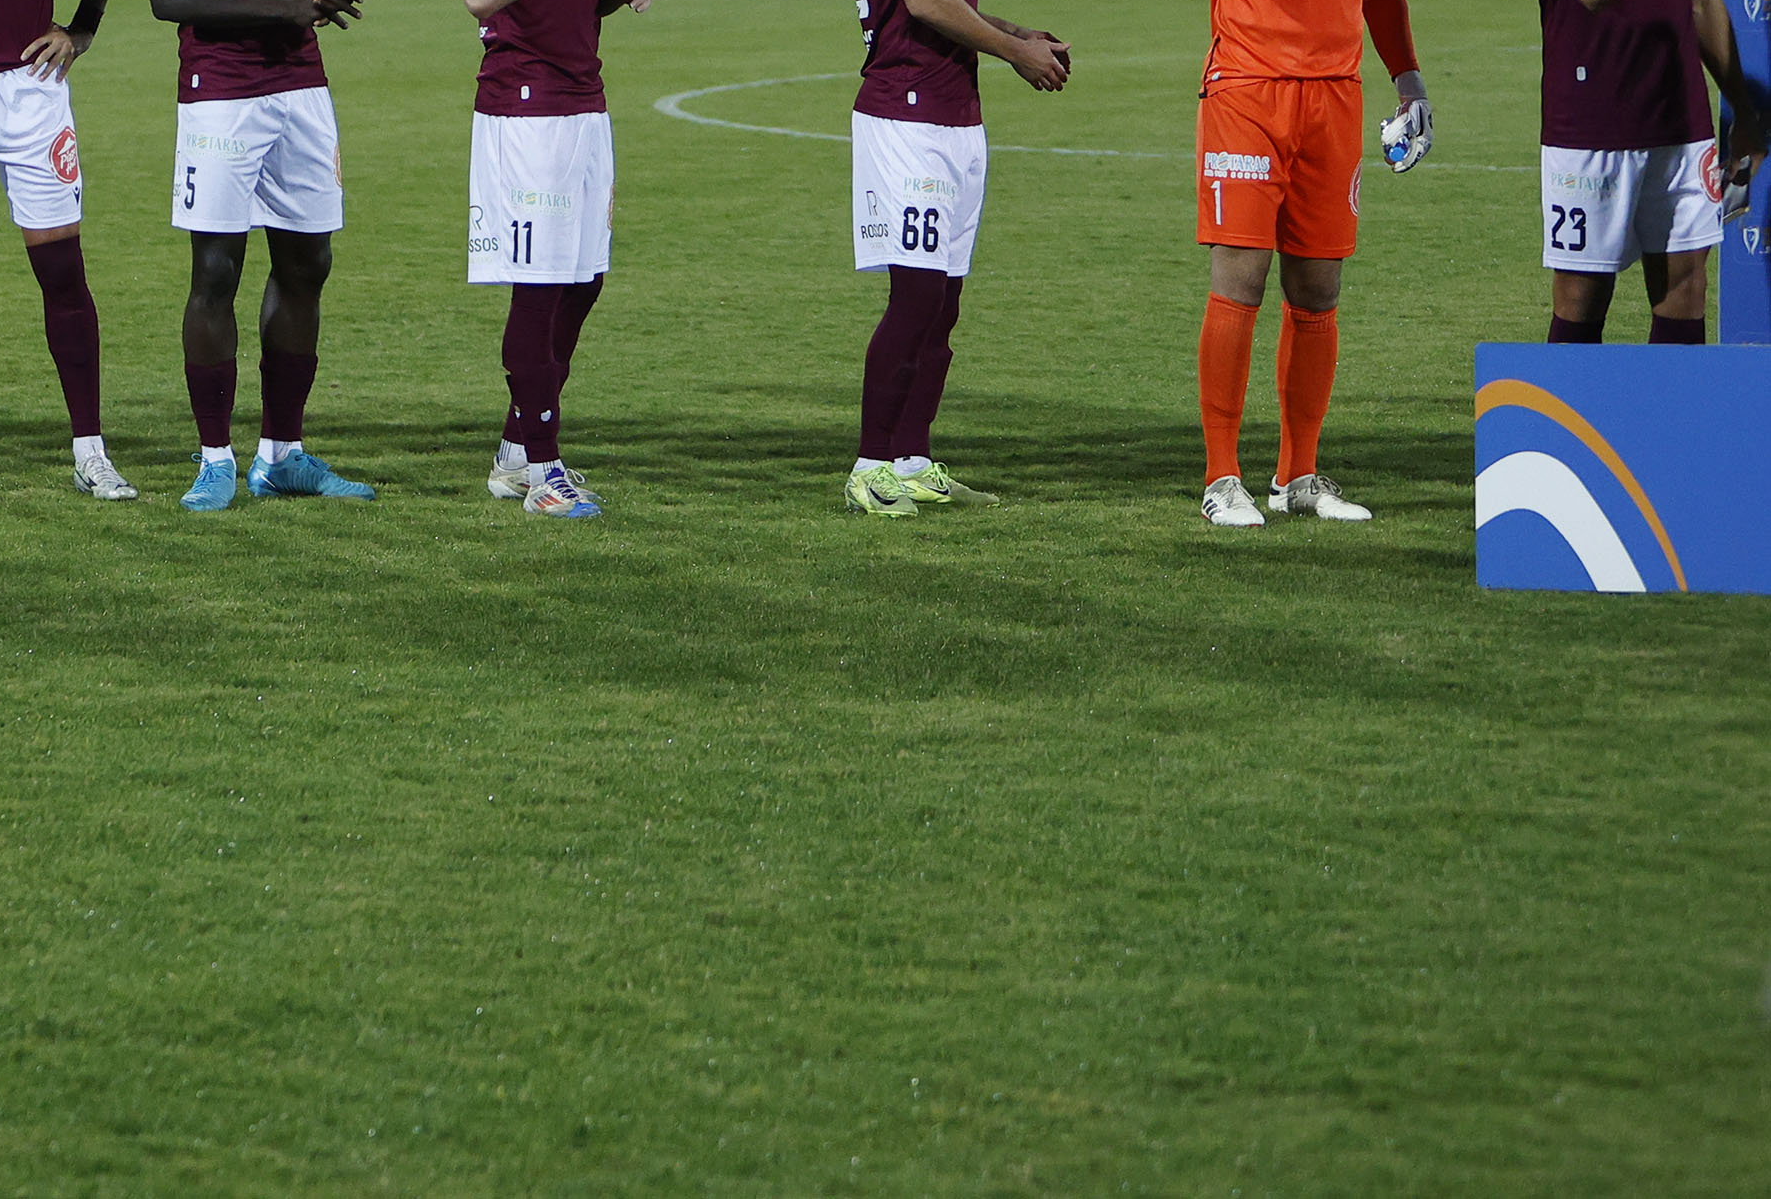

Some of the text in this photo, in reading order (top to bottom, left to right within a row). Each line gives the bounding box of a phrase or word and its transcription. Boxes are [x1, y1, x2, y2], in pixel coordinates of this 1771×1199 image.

[1205, 152, 1270, 173] PROTARAS
[184, 166, 196, 210] 5
[1210, 180, 1223, 226] 1
[511, 220, 533, 264] 11
[901, 206, 940, 253] 66
[1551, 204, 1587, 251] 23
